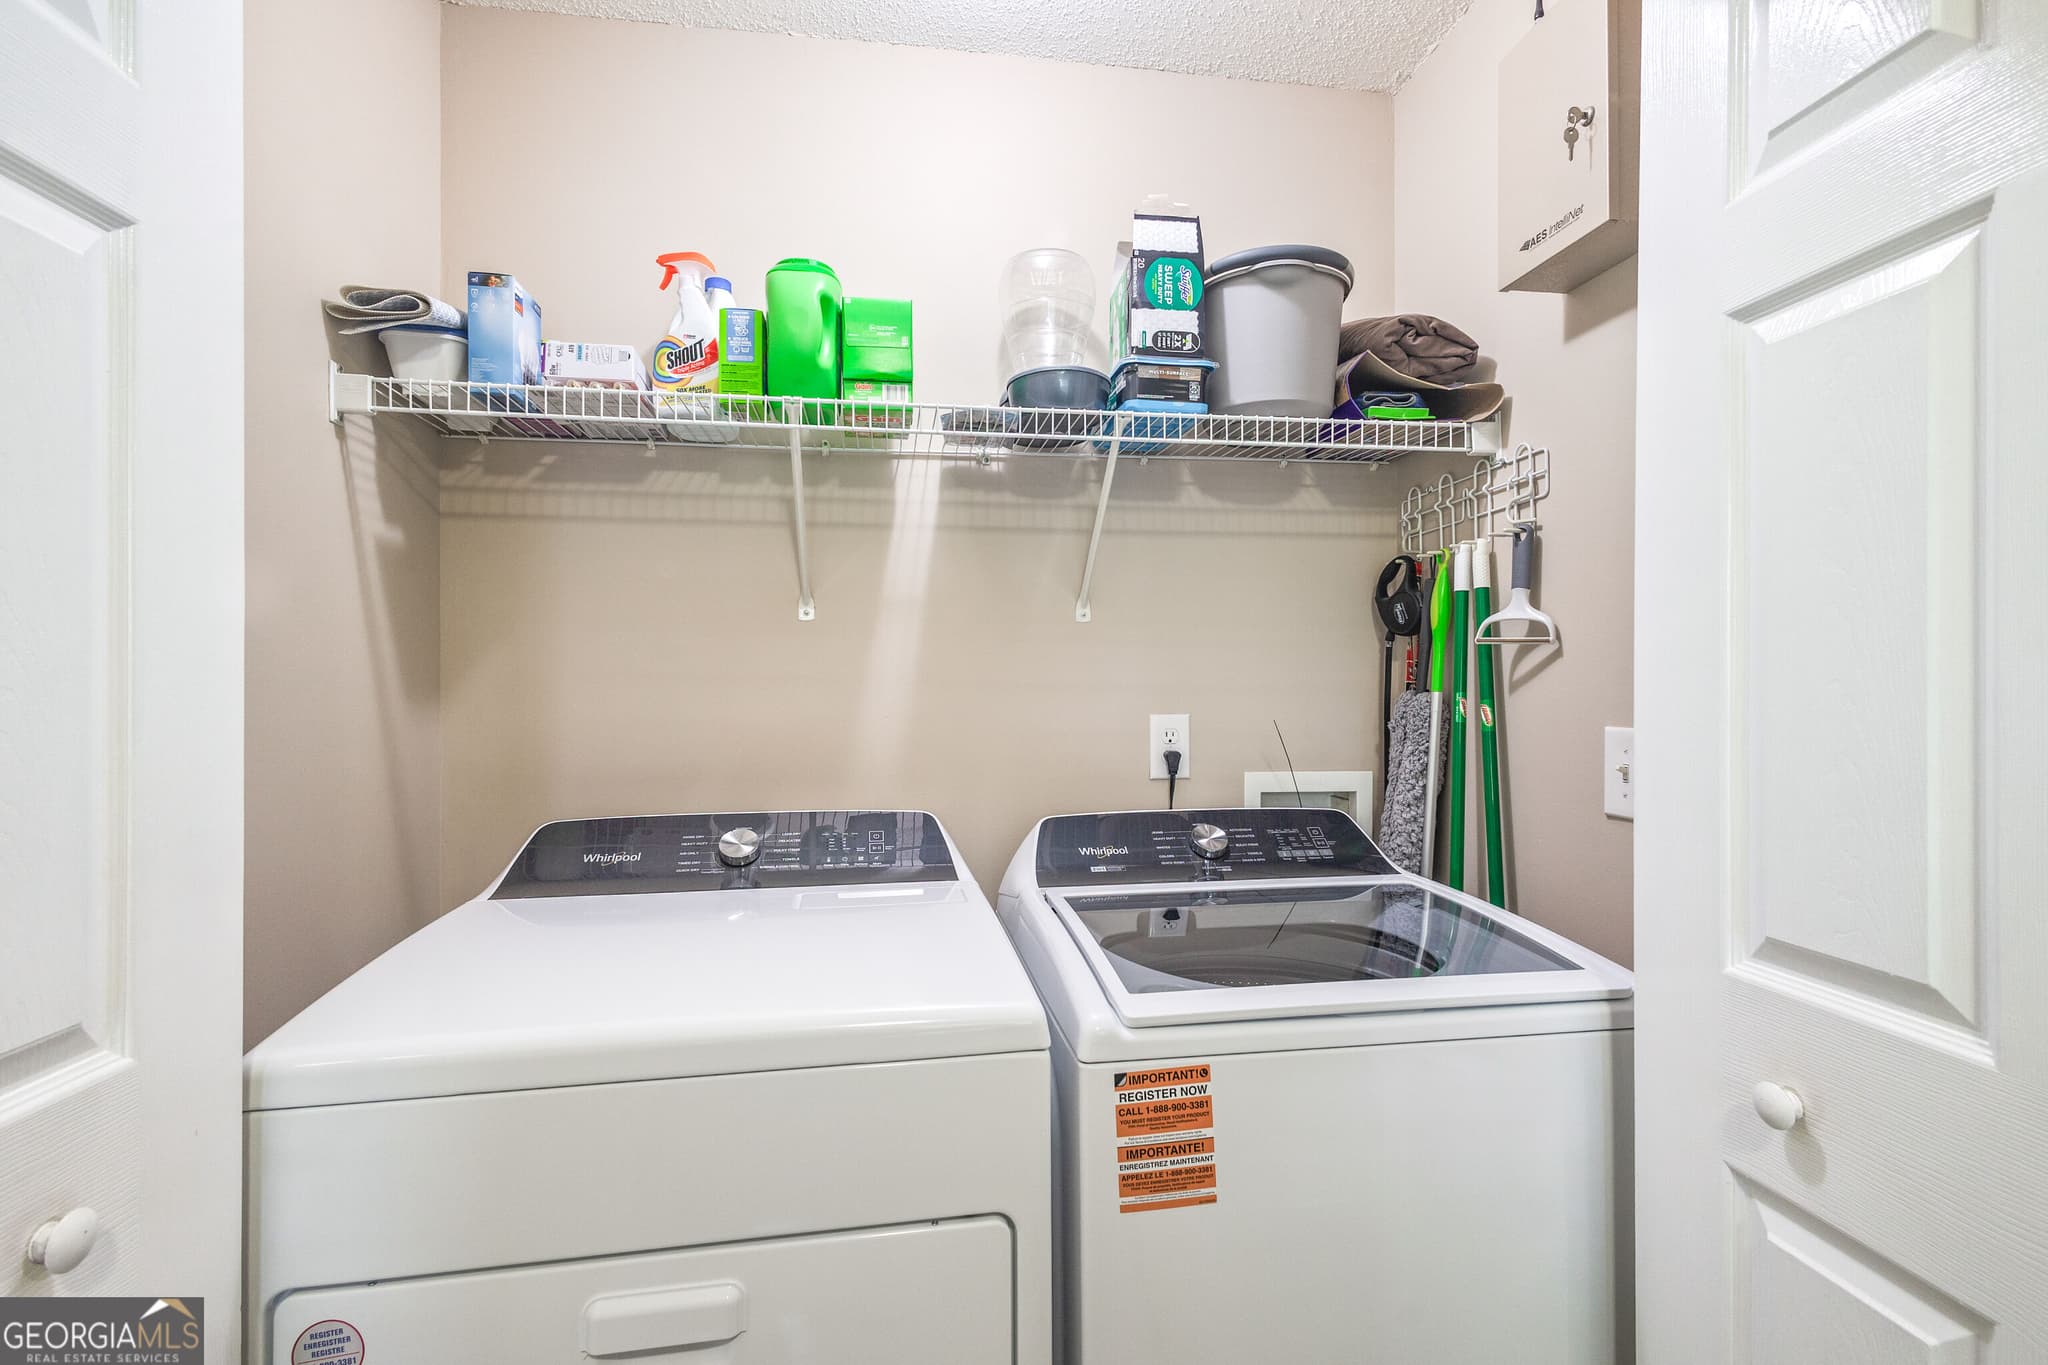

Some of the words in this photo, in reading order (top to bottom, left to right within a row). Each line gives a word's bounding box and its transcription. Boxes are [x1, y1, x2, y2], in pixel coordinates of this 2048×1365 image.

[1529, 228, 1548, 249] AES
[1164, 264, 1173, 305] SWEEP
[1178, 265, 1193, 305] Swiffer
[666, 338, 705, 370] SHOUT
[583, 851, 642, 867] Whirlpool
[1078, 845, 1129, 859] Whirlpool
[1128, 1068, 1199, 1086] IMPORTANT!
[1119, 1087, 1178, 1103] REGISTER
[1180, 1084, 1208, 1097] NOW
[1118, 1107, 1144, 1117] CALL
[1146, 1099, 1209, 1114] 1-888-900-3381
[1126, 1142, 1205, 1160] IMPORTANTE!
[1119, 1160, 1168, 1171] ENREGISTREZ
[1169, 1154, 1214, 1166] MAINTENANT
[1121, 1172, 1153, 1182] APPELEZ
[303, 1335, 352, 1351] ENREGISTRER
[309, 1328, 344, 1340] REGISTER
[311, 1345, 345, 1358] REGISTRE
